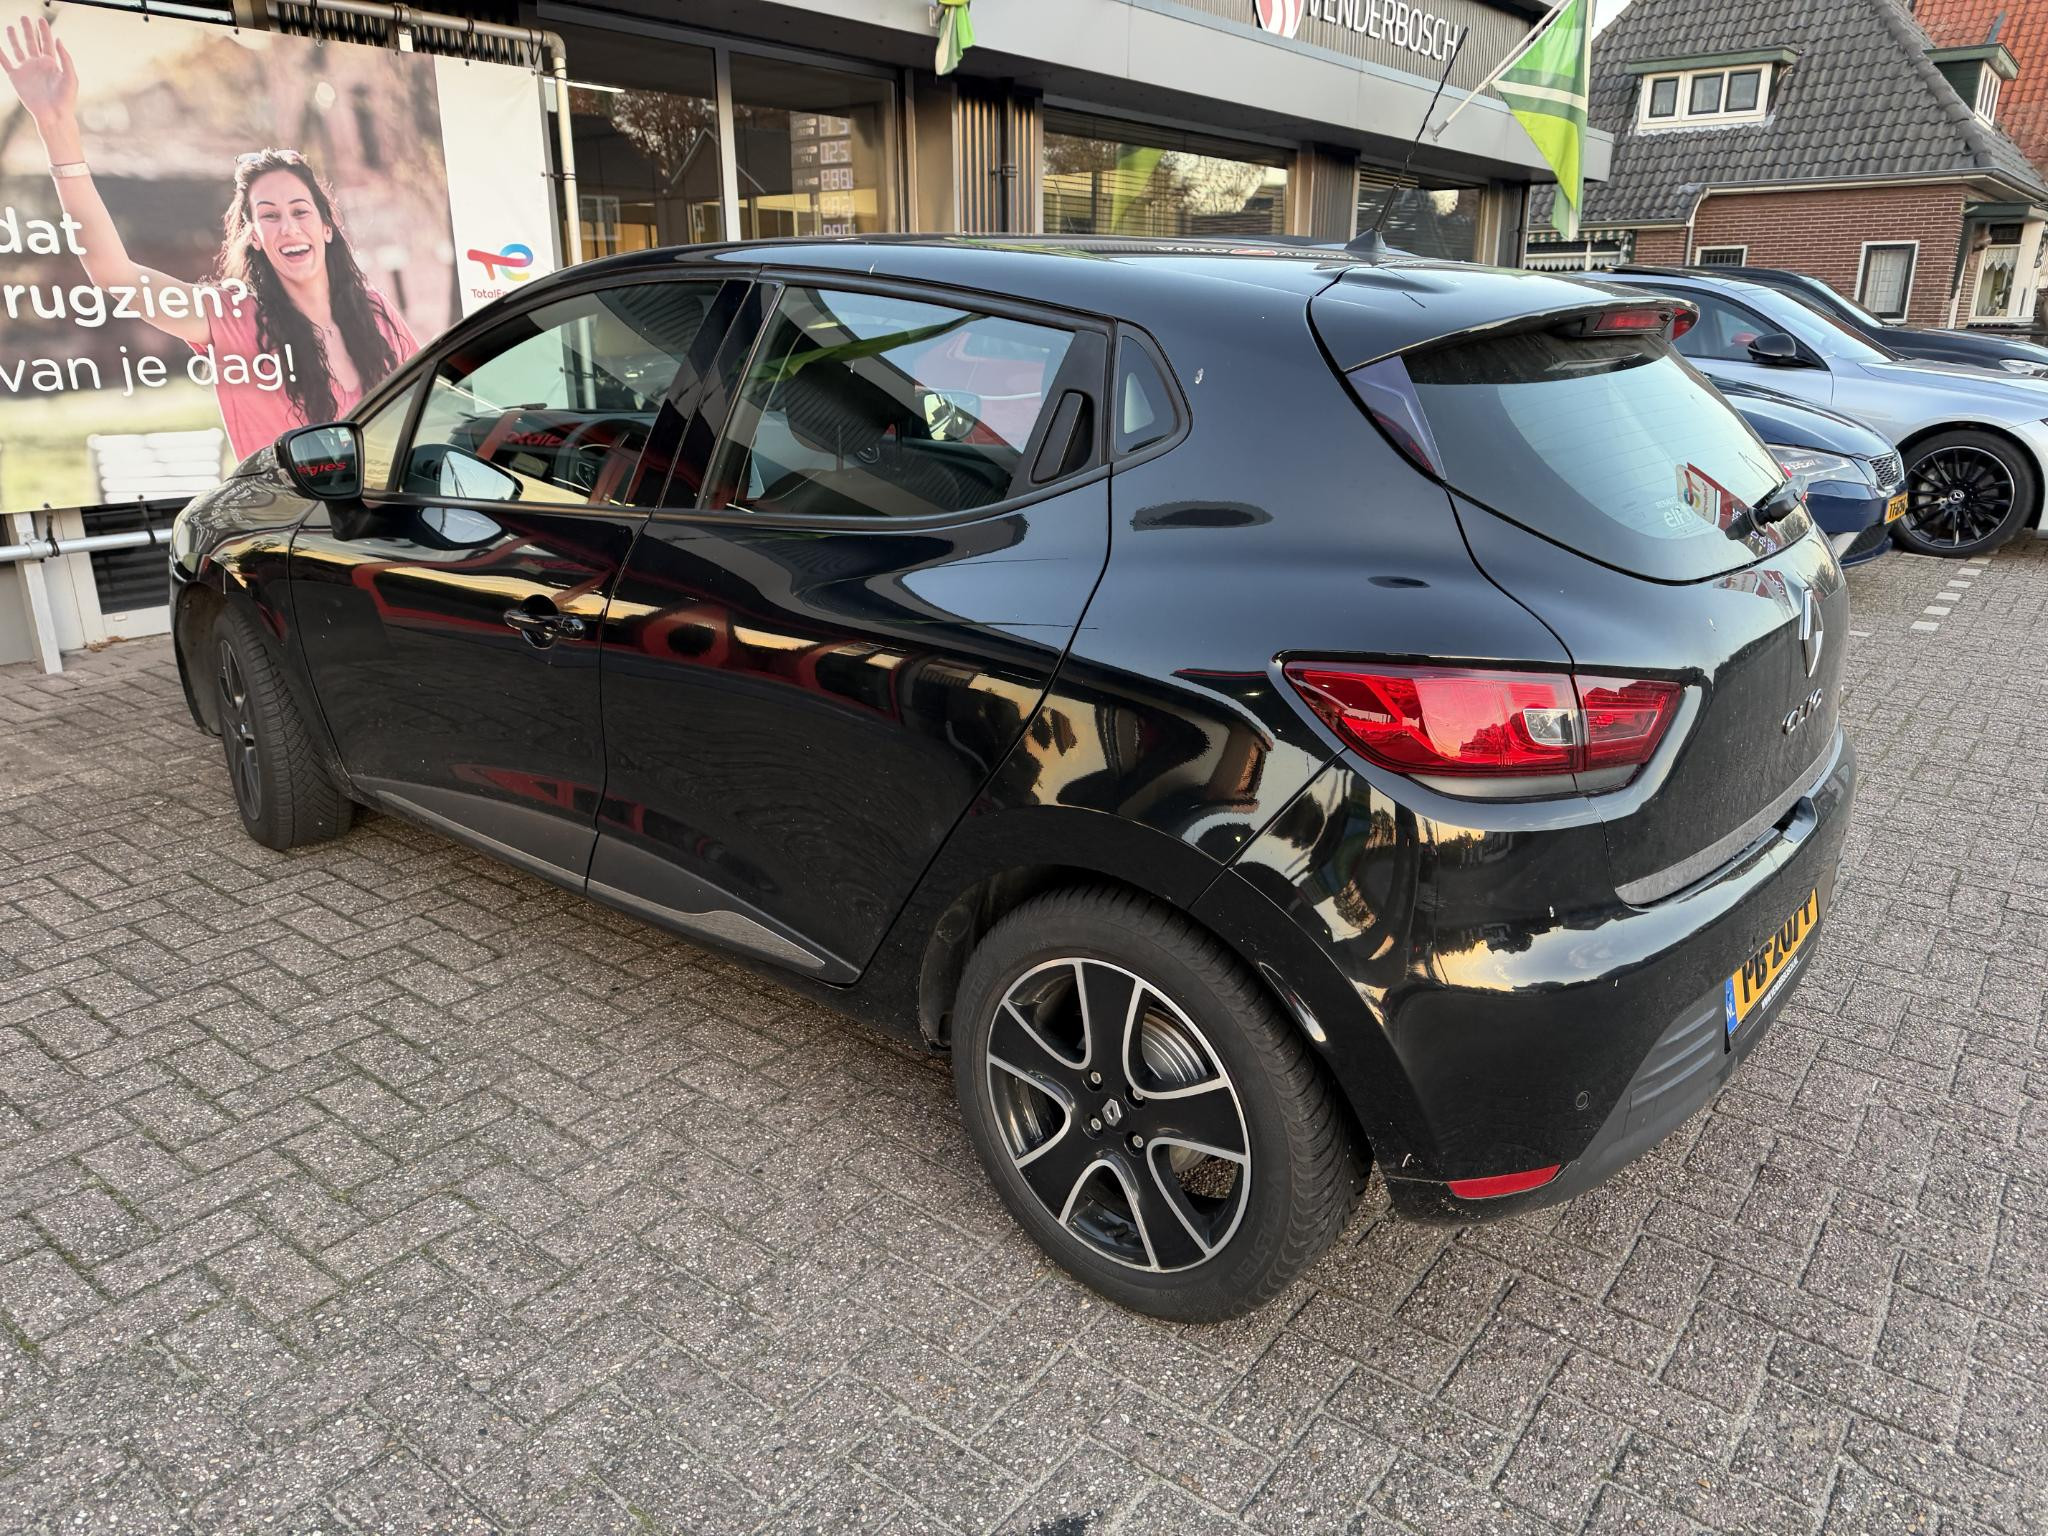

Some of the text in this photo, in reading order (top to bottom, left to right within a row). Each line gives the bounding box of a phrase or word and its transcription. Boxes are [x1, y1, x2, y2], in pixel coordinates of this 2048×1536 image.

[0, 206, 87, 255] dat
[3, 275, 248, 328] rugzien?
[0, 343, 297, 397] van je dag!
